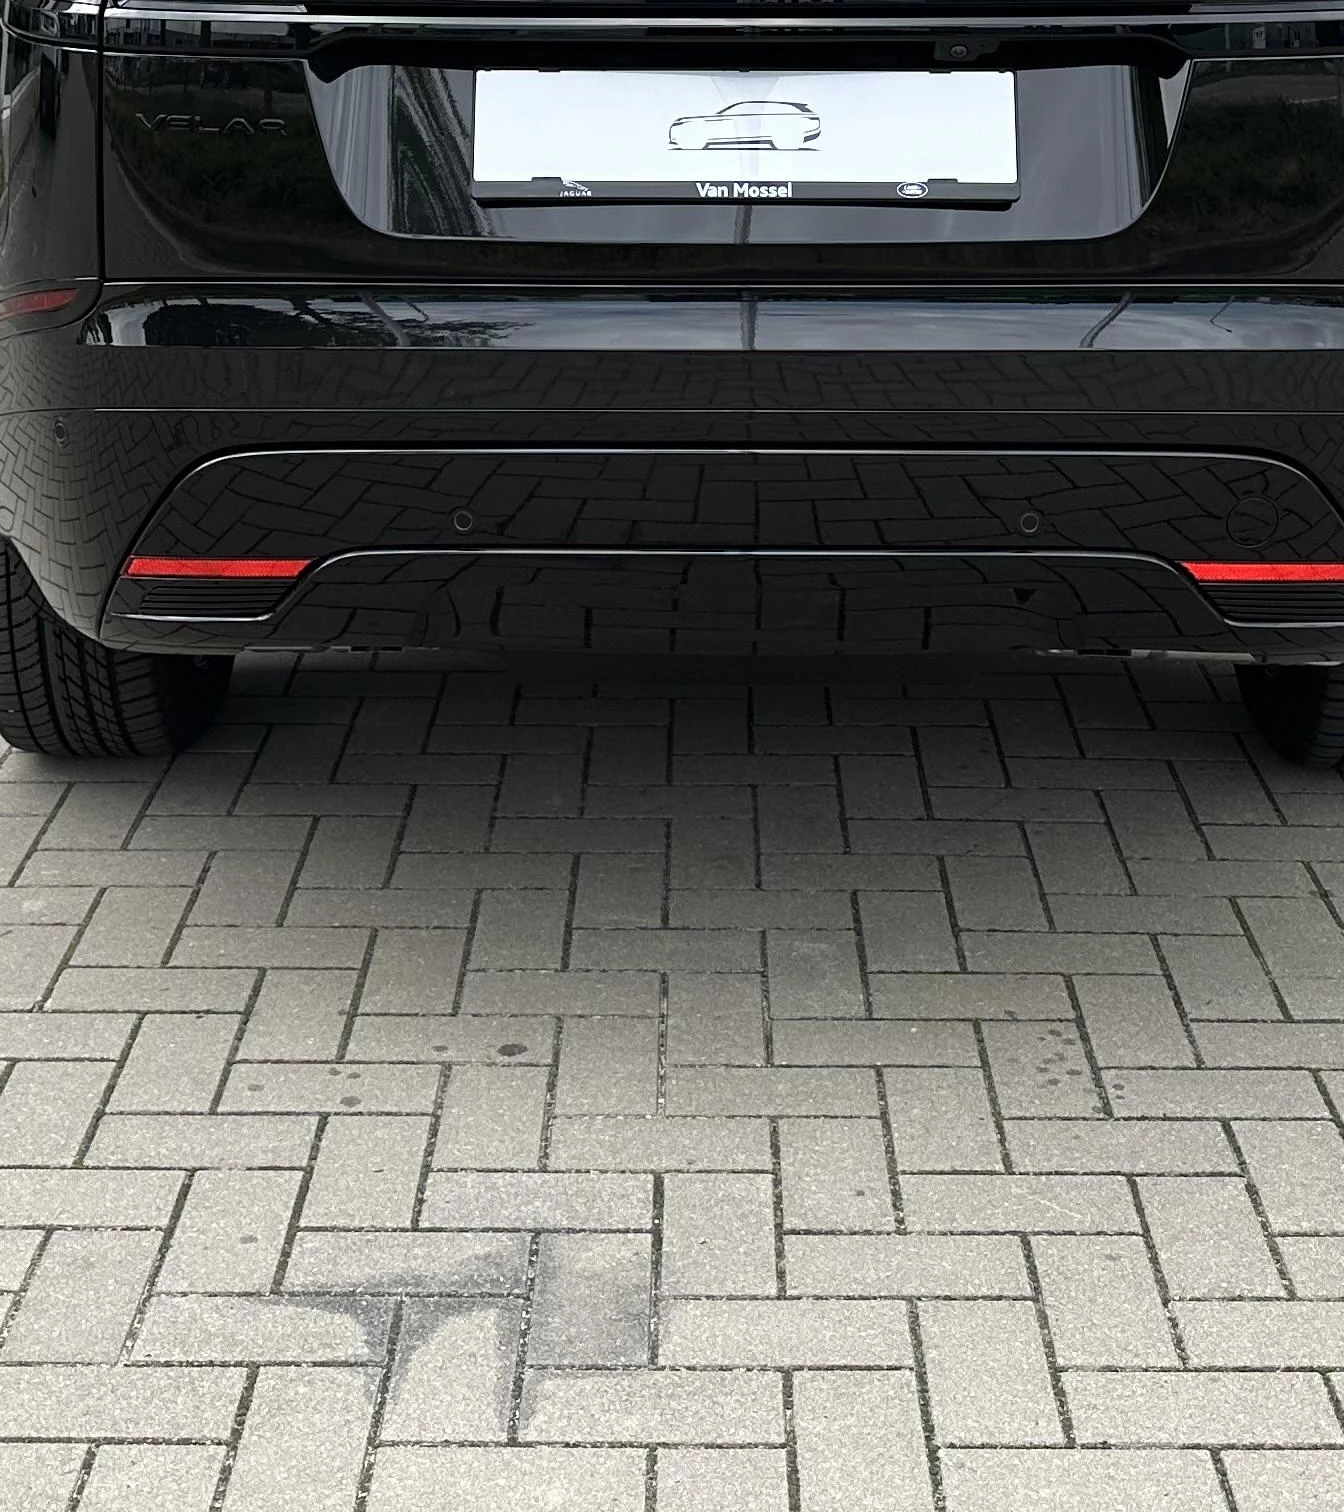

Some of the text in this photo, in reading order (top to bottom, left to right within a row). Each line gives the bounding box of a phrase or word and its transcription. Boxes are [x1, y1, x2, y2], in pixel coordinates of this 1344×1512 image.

[135, 111, 288, 137] VELAR
[695, 181, 793, 198] Van Mossel
